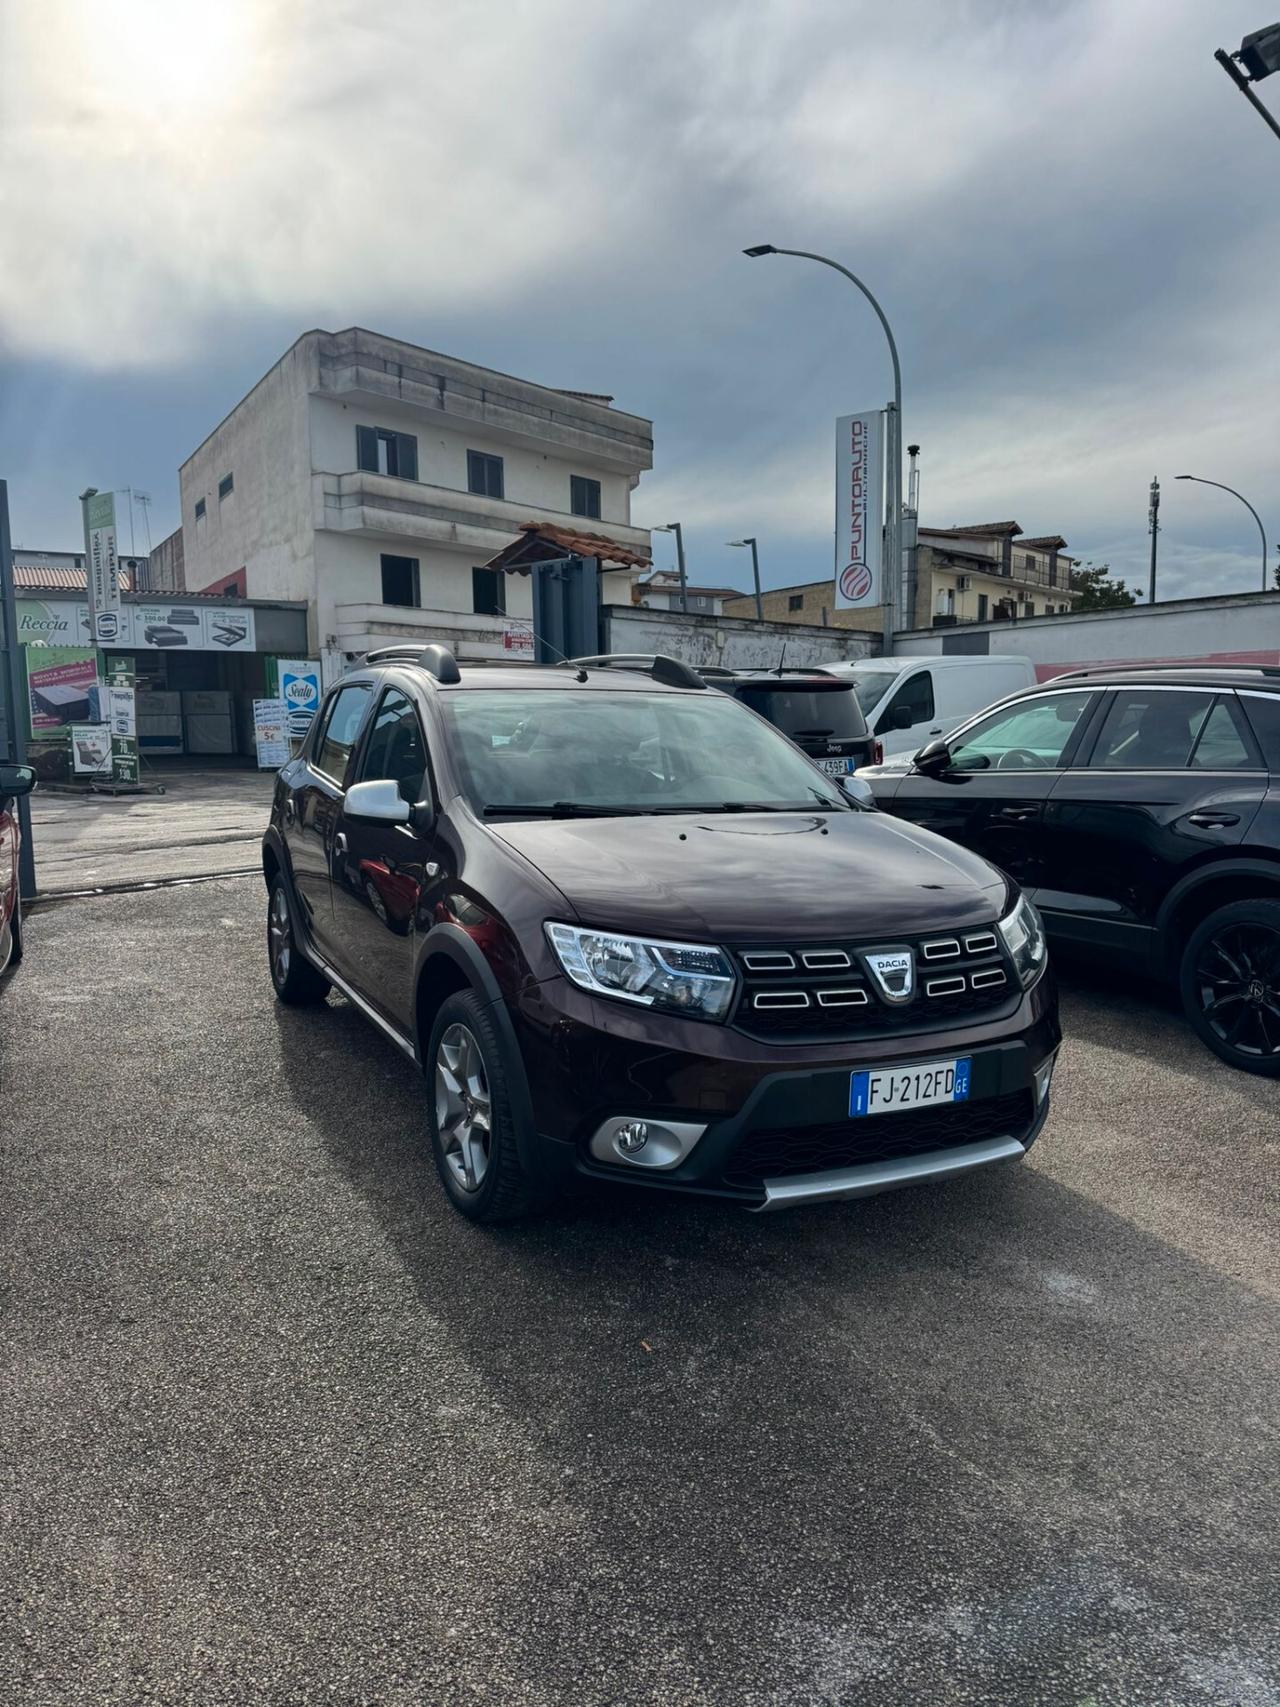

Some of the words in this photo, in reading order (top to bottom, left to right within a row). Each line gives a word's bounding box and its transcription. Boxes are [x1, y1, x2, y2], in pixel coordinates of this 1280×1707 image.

[851, 420, 862, 561] PUNTOAUTO
[107, 536, 117, 600] TEMPUR
[19, 614, 68, 631] Reccia
[288, 684, 313, 698] Sealy
[257, 724, 280, 732] CUSCINI
[827, 744, 842, 753] Jeep
[877, 959, 908, 969] DACIA
[955, 1078, 967, 1094] GE
